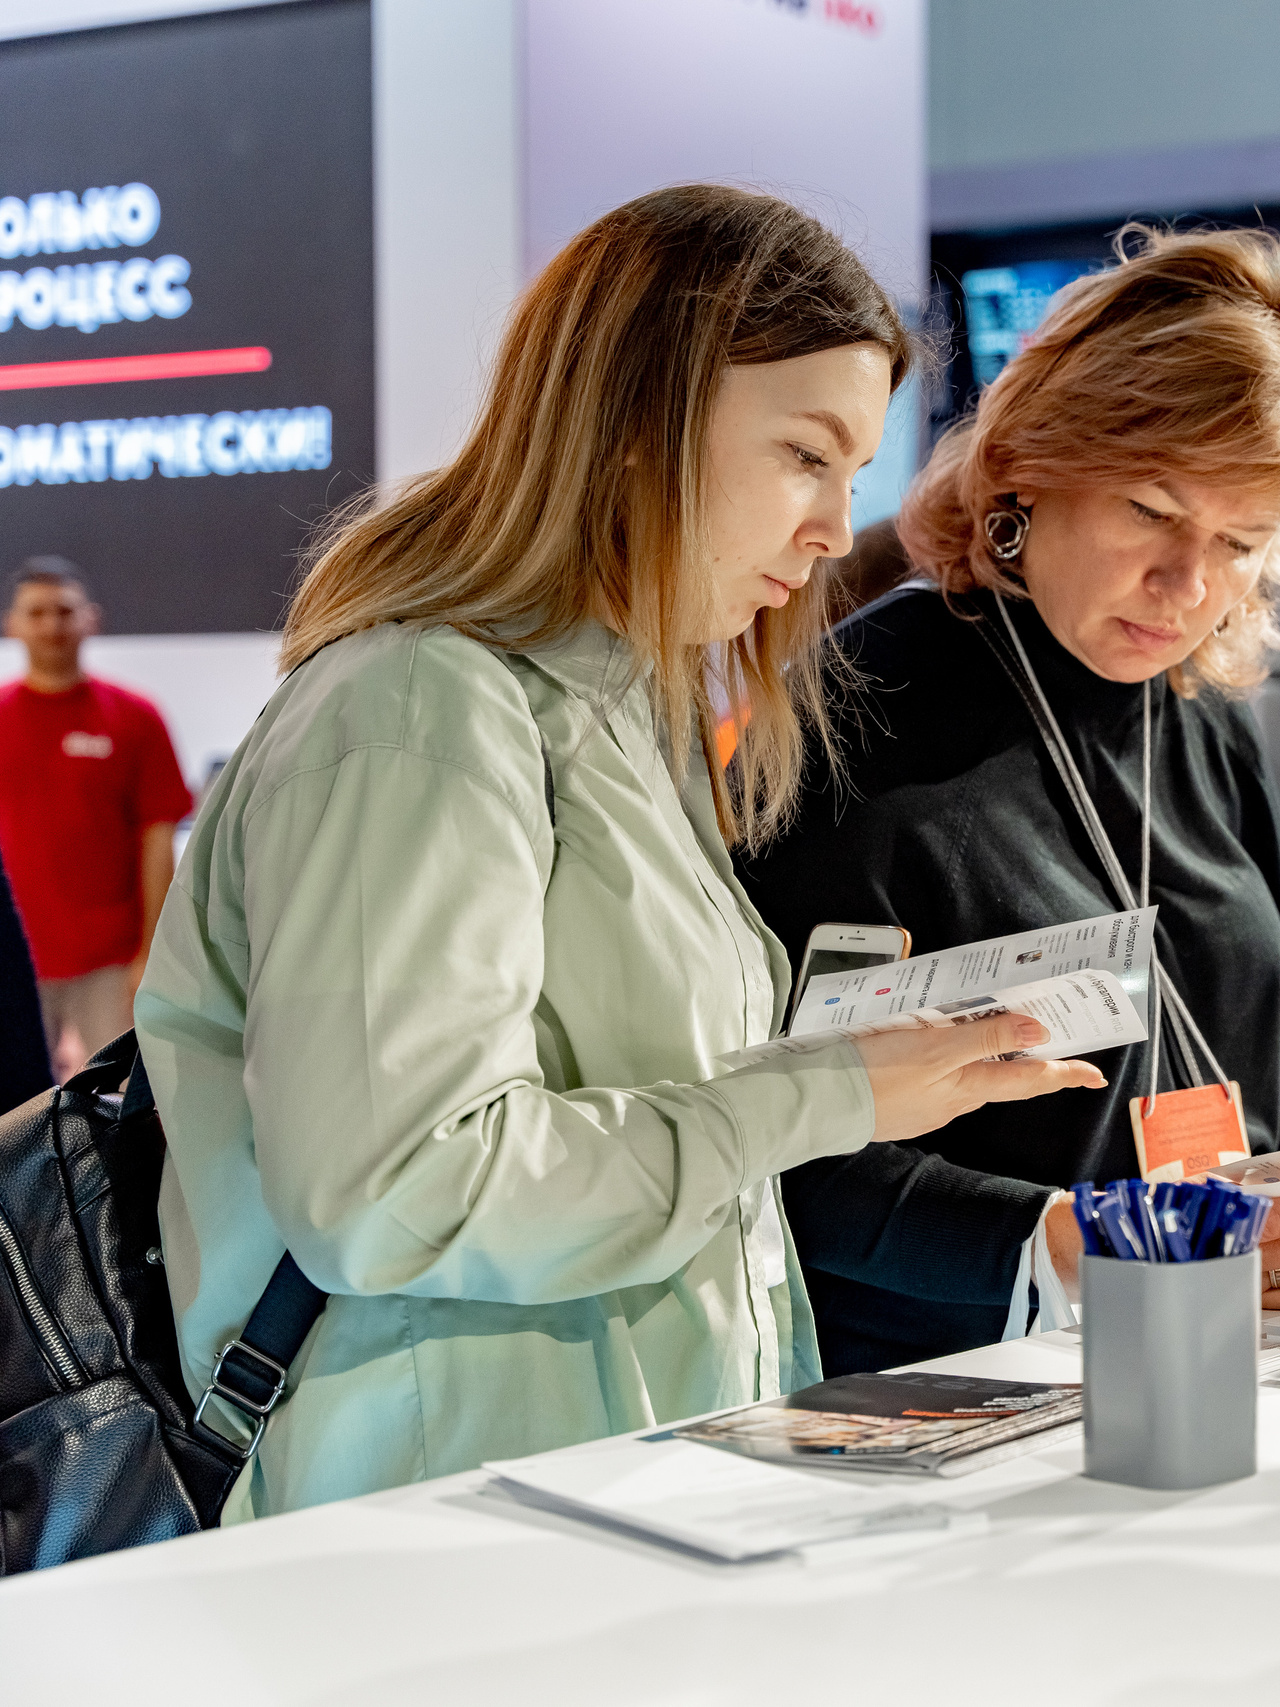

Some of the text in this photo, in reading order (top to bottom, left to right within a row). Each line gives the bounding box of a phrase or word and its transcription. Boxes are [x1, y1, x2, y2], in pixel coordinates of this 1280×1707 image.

[1124, 925, 1139, 953] быстрого
[917, 995, 927, 1009] прив
[1091, 979, 1121, 1016] бухгалтерии
